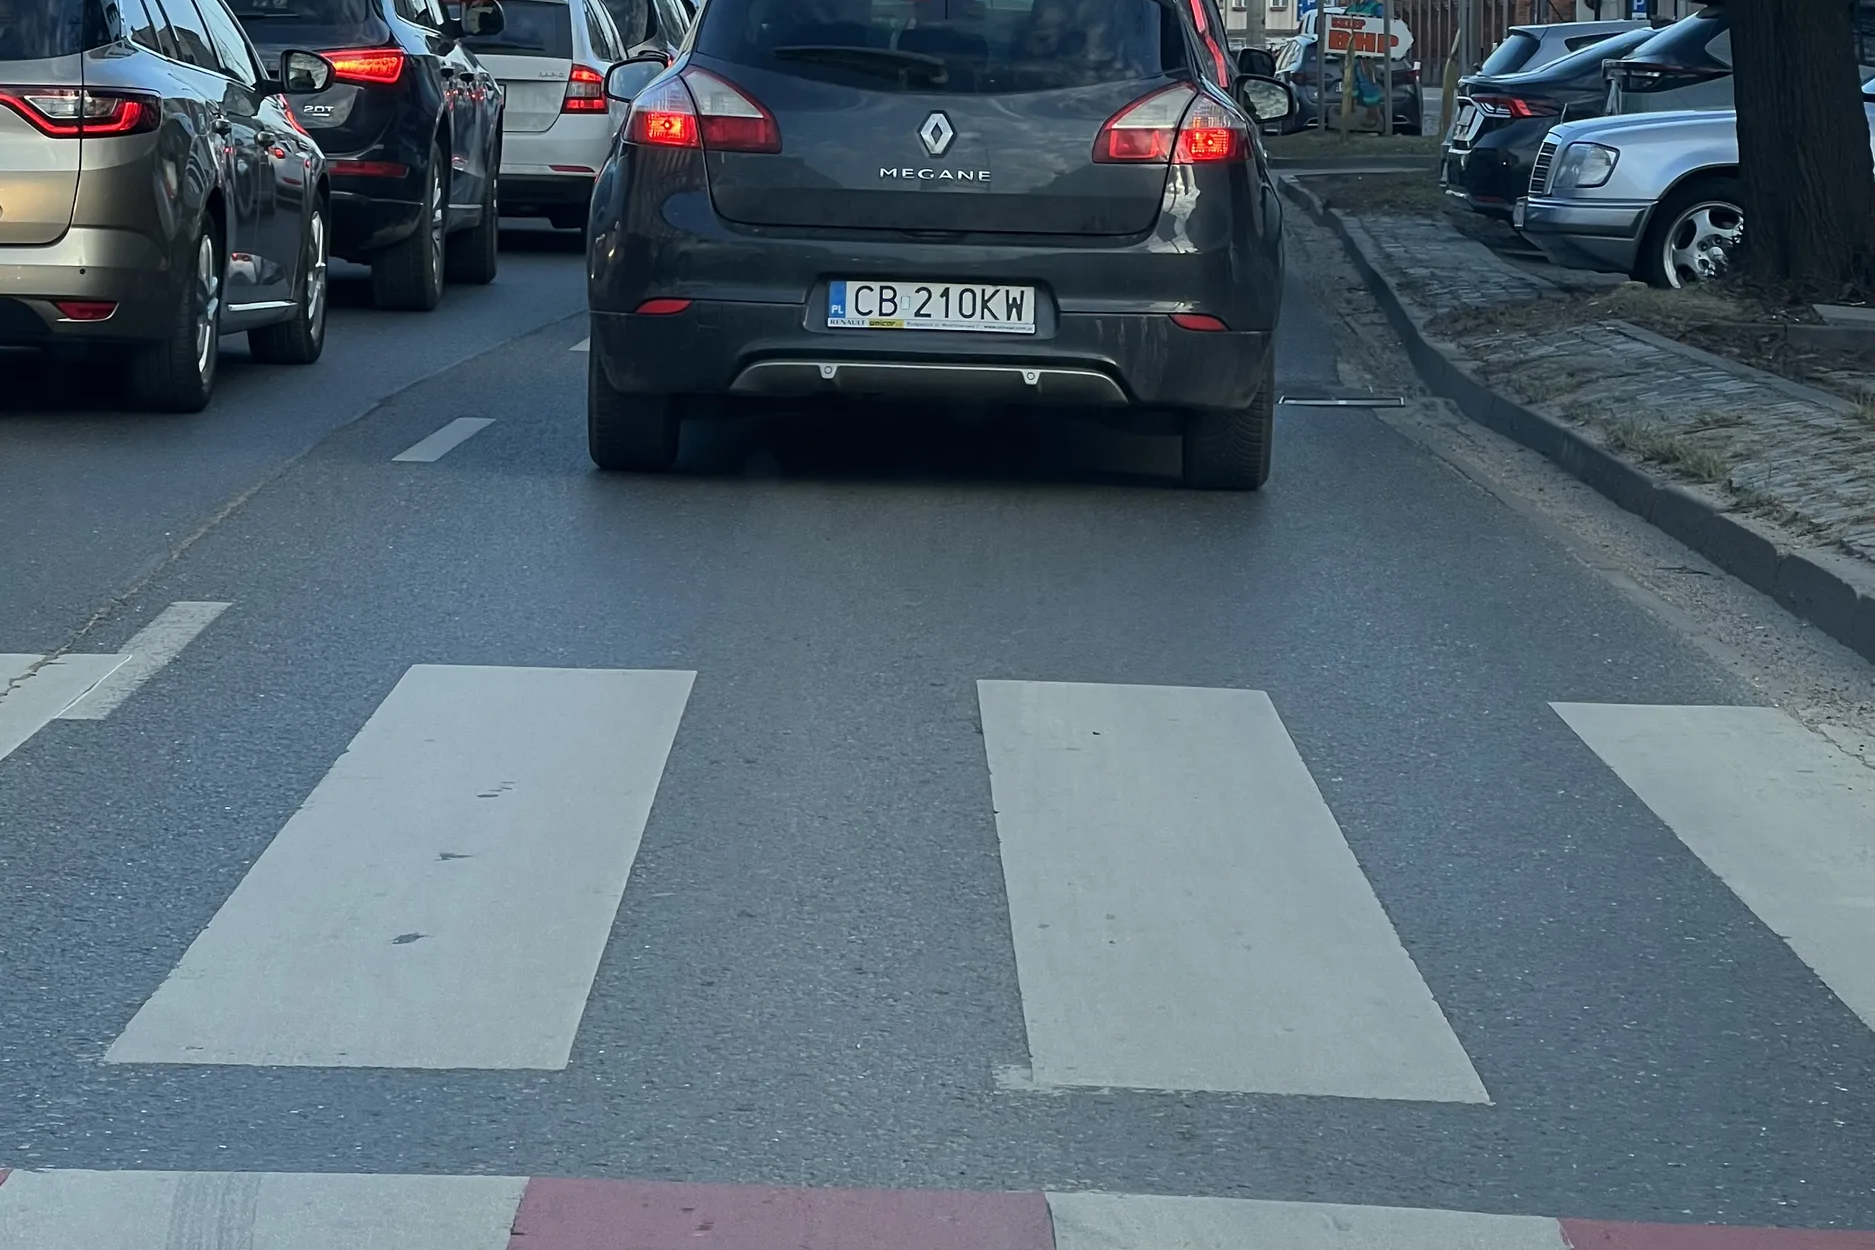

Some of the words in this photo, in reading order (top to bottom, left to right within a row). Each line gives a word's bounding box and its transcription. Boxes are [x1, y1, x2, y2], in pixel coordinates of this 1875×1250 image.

[1328, 29, 1399, 54] BHP
[879, 167, 992, 182] MEGANE
[830, 304, 844, 314] PL
[854, 285, 898, 317] CB
[913, 286, 1025, 322] 210KW
